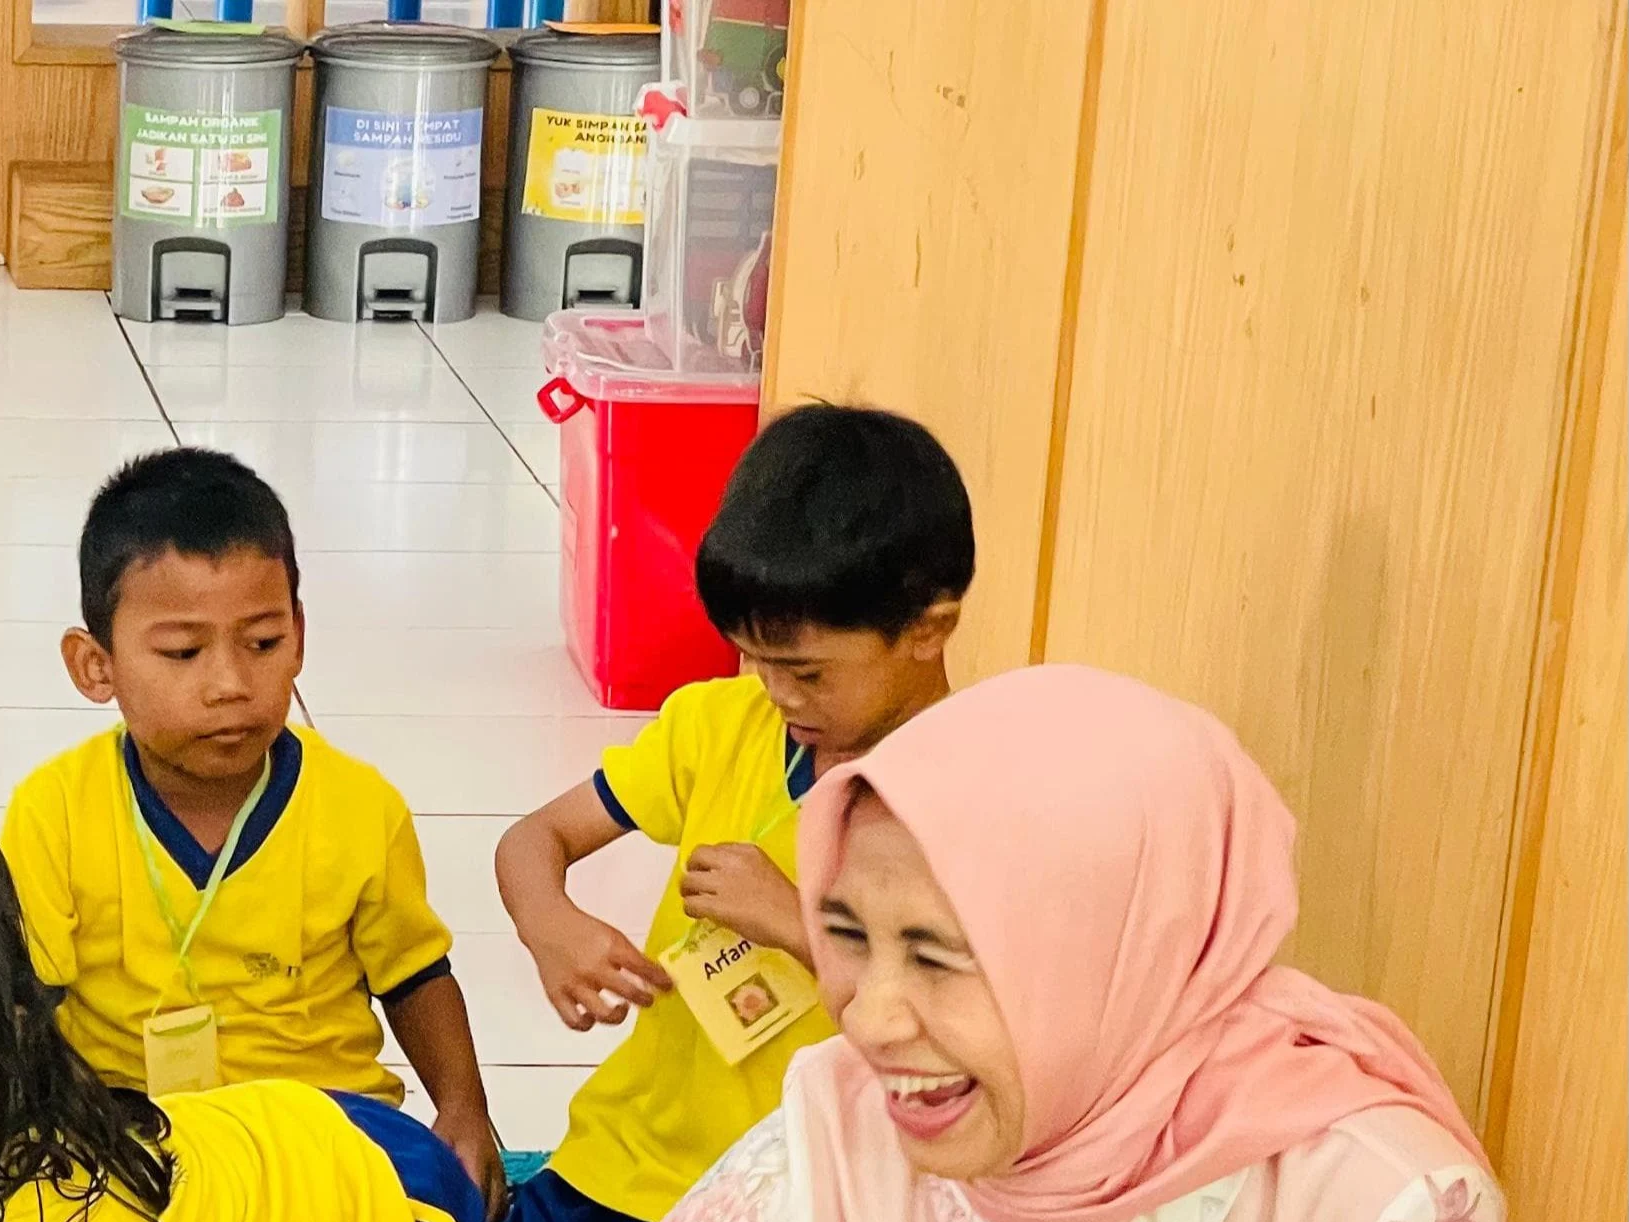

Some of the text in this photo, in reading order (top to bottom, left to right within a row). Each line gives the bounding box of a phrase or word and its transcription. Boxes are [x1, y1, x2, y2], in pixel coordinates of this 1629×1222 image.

[145, 112, 198, 127] SAMPAH
[356, 119, 461, 132] DI SINI TMPAT
[546, 115, 572, 127] YUK
[576, 119, 630, 132] SIMPAN
[136, 128, 187, 143] JADIKAN
[354, 133, 413, 145] SAMPAH
[703, 939, 752, 980] Arfan
